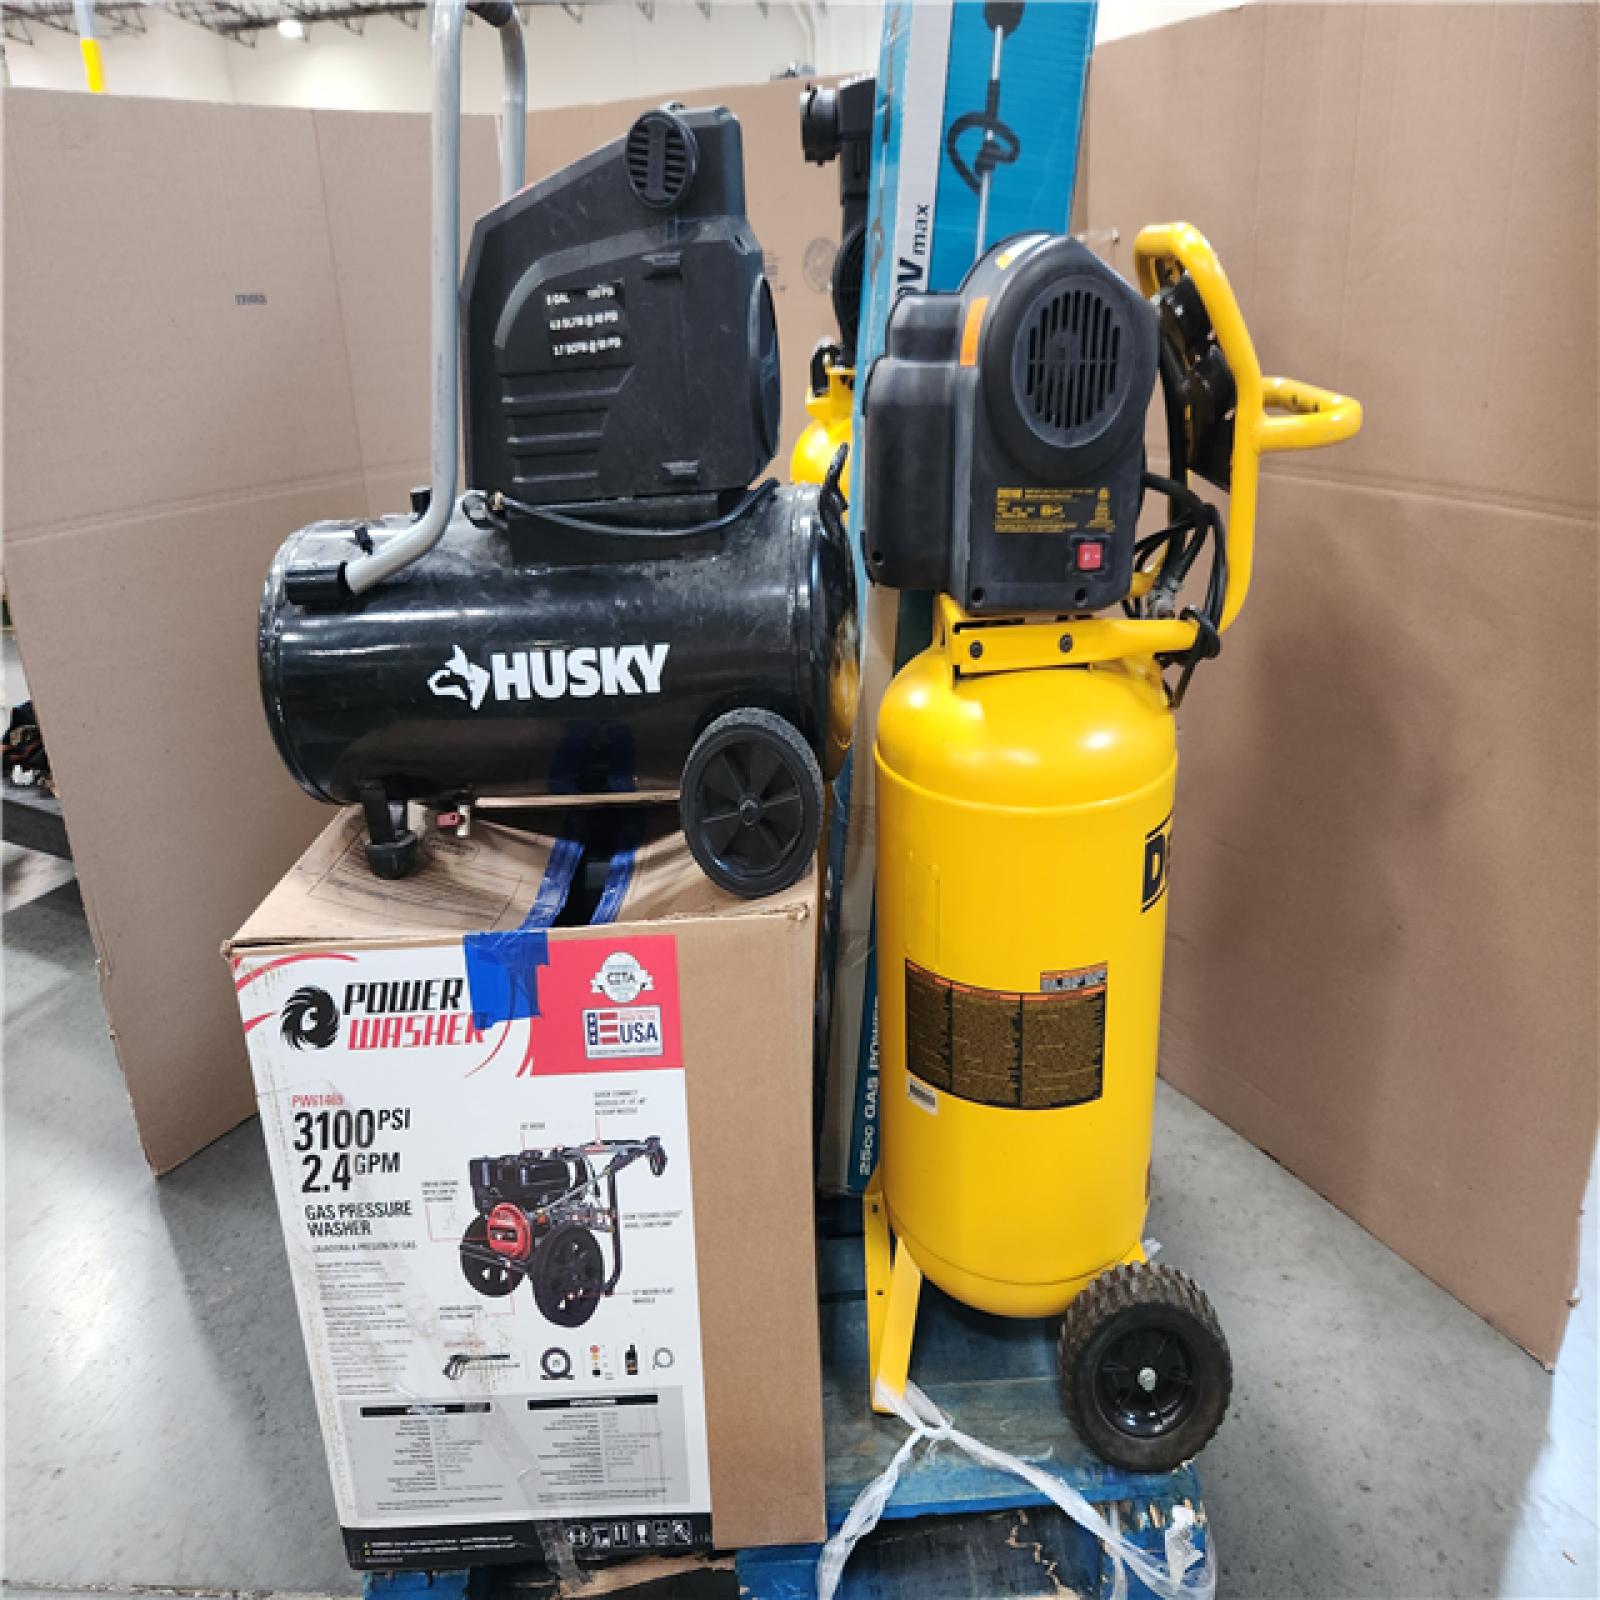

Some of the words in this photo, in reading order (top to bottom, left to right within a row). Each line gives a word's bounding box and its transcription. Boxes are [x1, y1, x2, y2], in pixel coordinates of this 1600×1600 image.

[913, 204, 930, 256] max
[490, 643, 671, 701] HUSKY
[343, 977, 464, 1015] POWER
[619, 1022, 658, 1043] USA
[293, 1109, 375, 1152] 3100
[377, 1107, 411, 1131] PSI
[302, 1152, 352, 1193] 2.4
[354, 1152, 401, 1175] GPM
[305, 1204, 336, 1220] GAS
[338, 1200, 413, 1219] PRESSURE
[307, 1219, 372, 1238] WASHER
